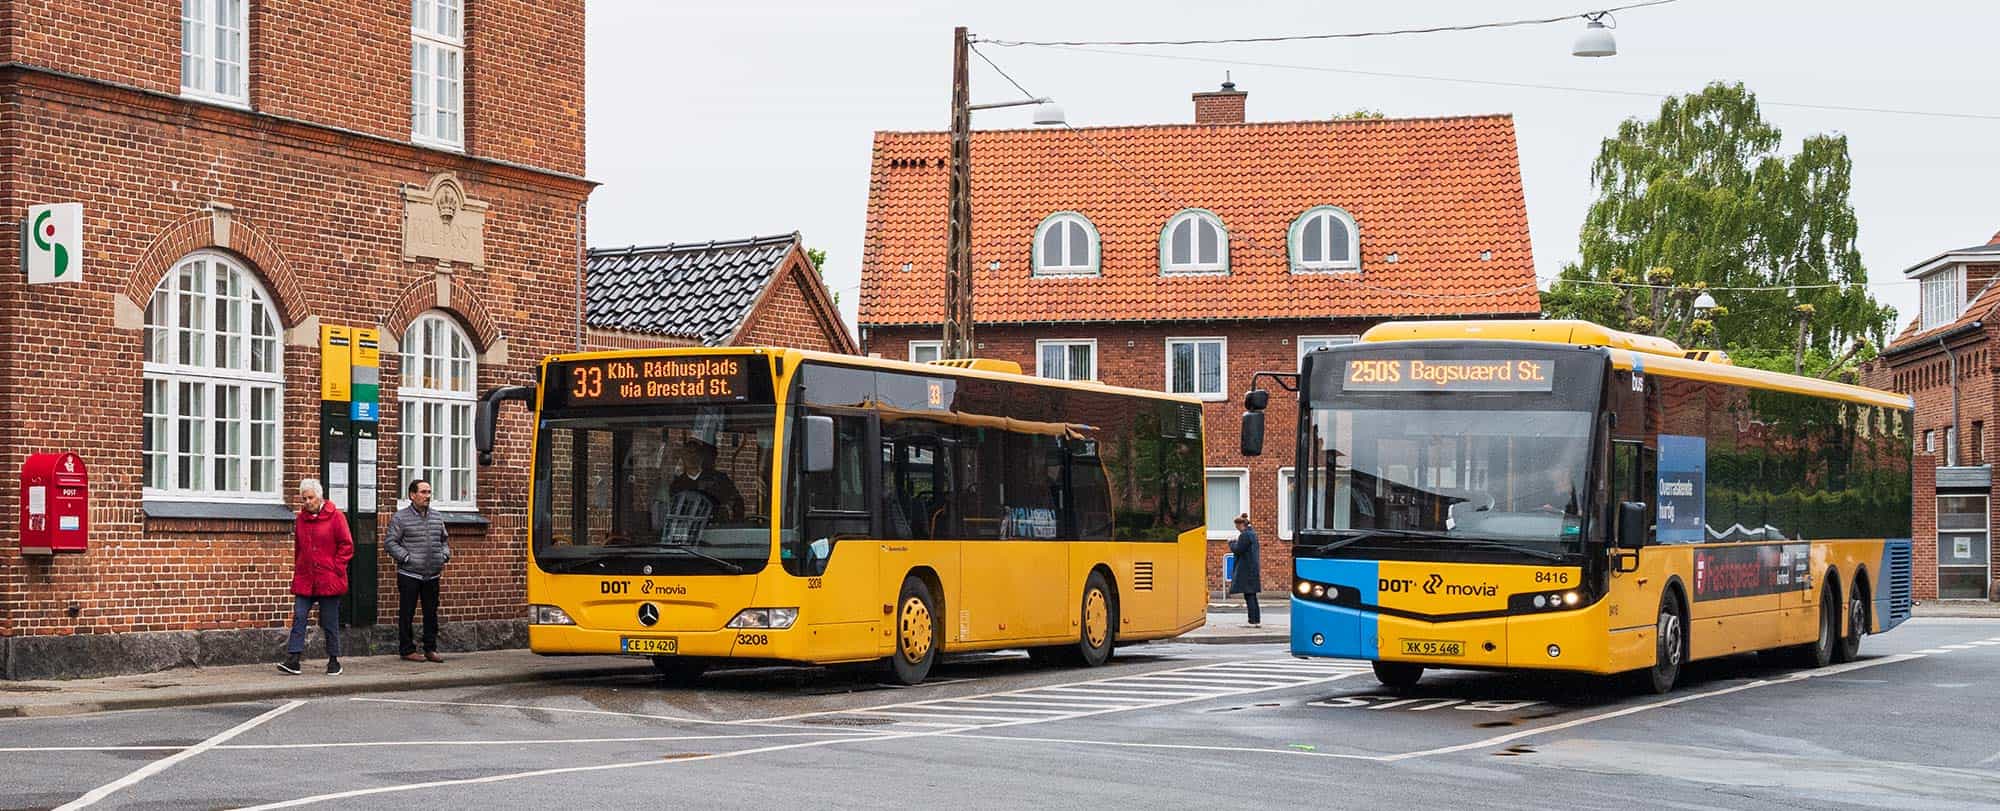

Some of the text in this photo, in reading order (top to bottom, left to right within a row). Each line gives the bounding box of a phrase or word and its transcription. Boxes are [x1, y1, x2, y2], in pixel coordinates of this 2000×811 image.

[607, 359, 738, 379] Kbh. Rådhusplads
[1351, 360, 1545, 385] 250S Bagsværd St.
[573, 367, 602, 398] 33
[620, 378, 732, 398] via Ørestad St.
[1632, 372, 1644, 393] bus
[928, 384, 941, 405] 33
[63, 488, 77, 496] POST
[808, 578, 822, 589] 3208
[1535, 572, 1568, 584] 8416
[601, 581, 687, 595] DOT movia
[1378, 578, 1499, 597] DOT movia
[628, 640, 675, 651] CE 19 420
[737, 634, 768, 646] 3208
[1407, 642, 1421, 652] XK
[1423, 643, 1437, 653] 95
